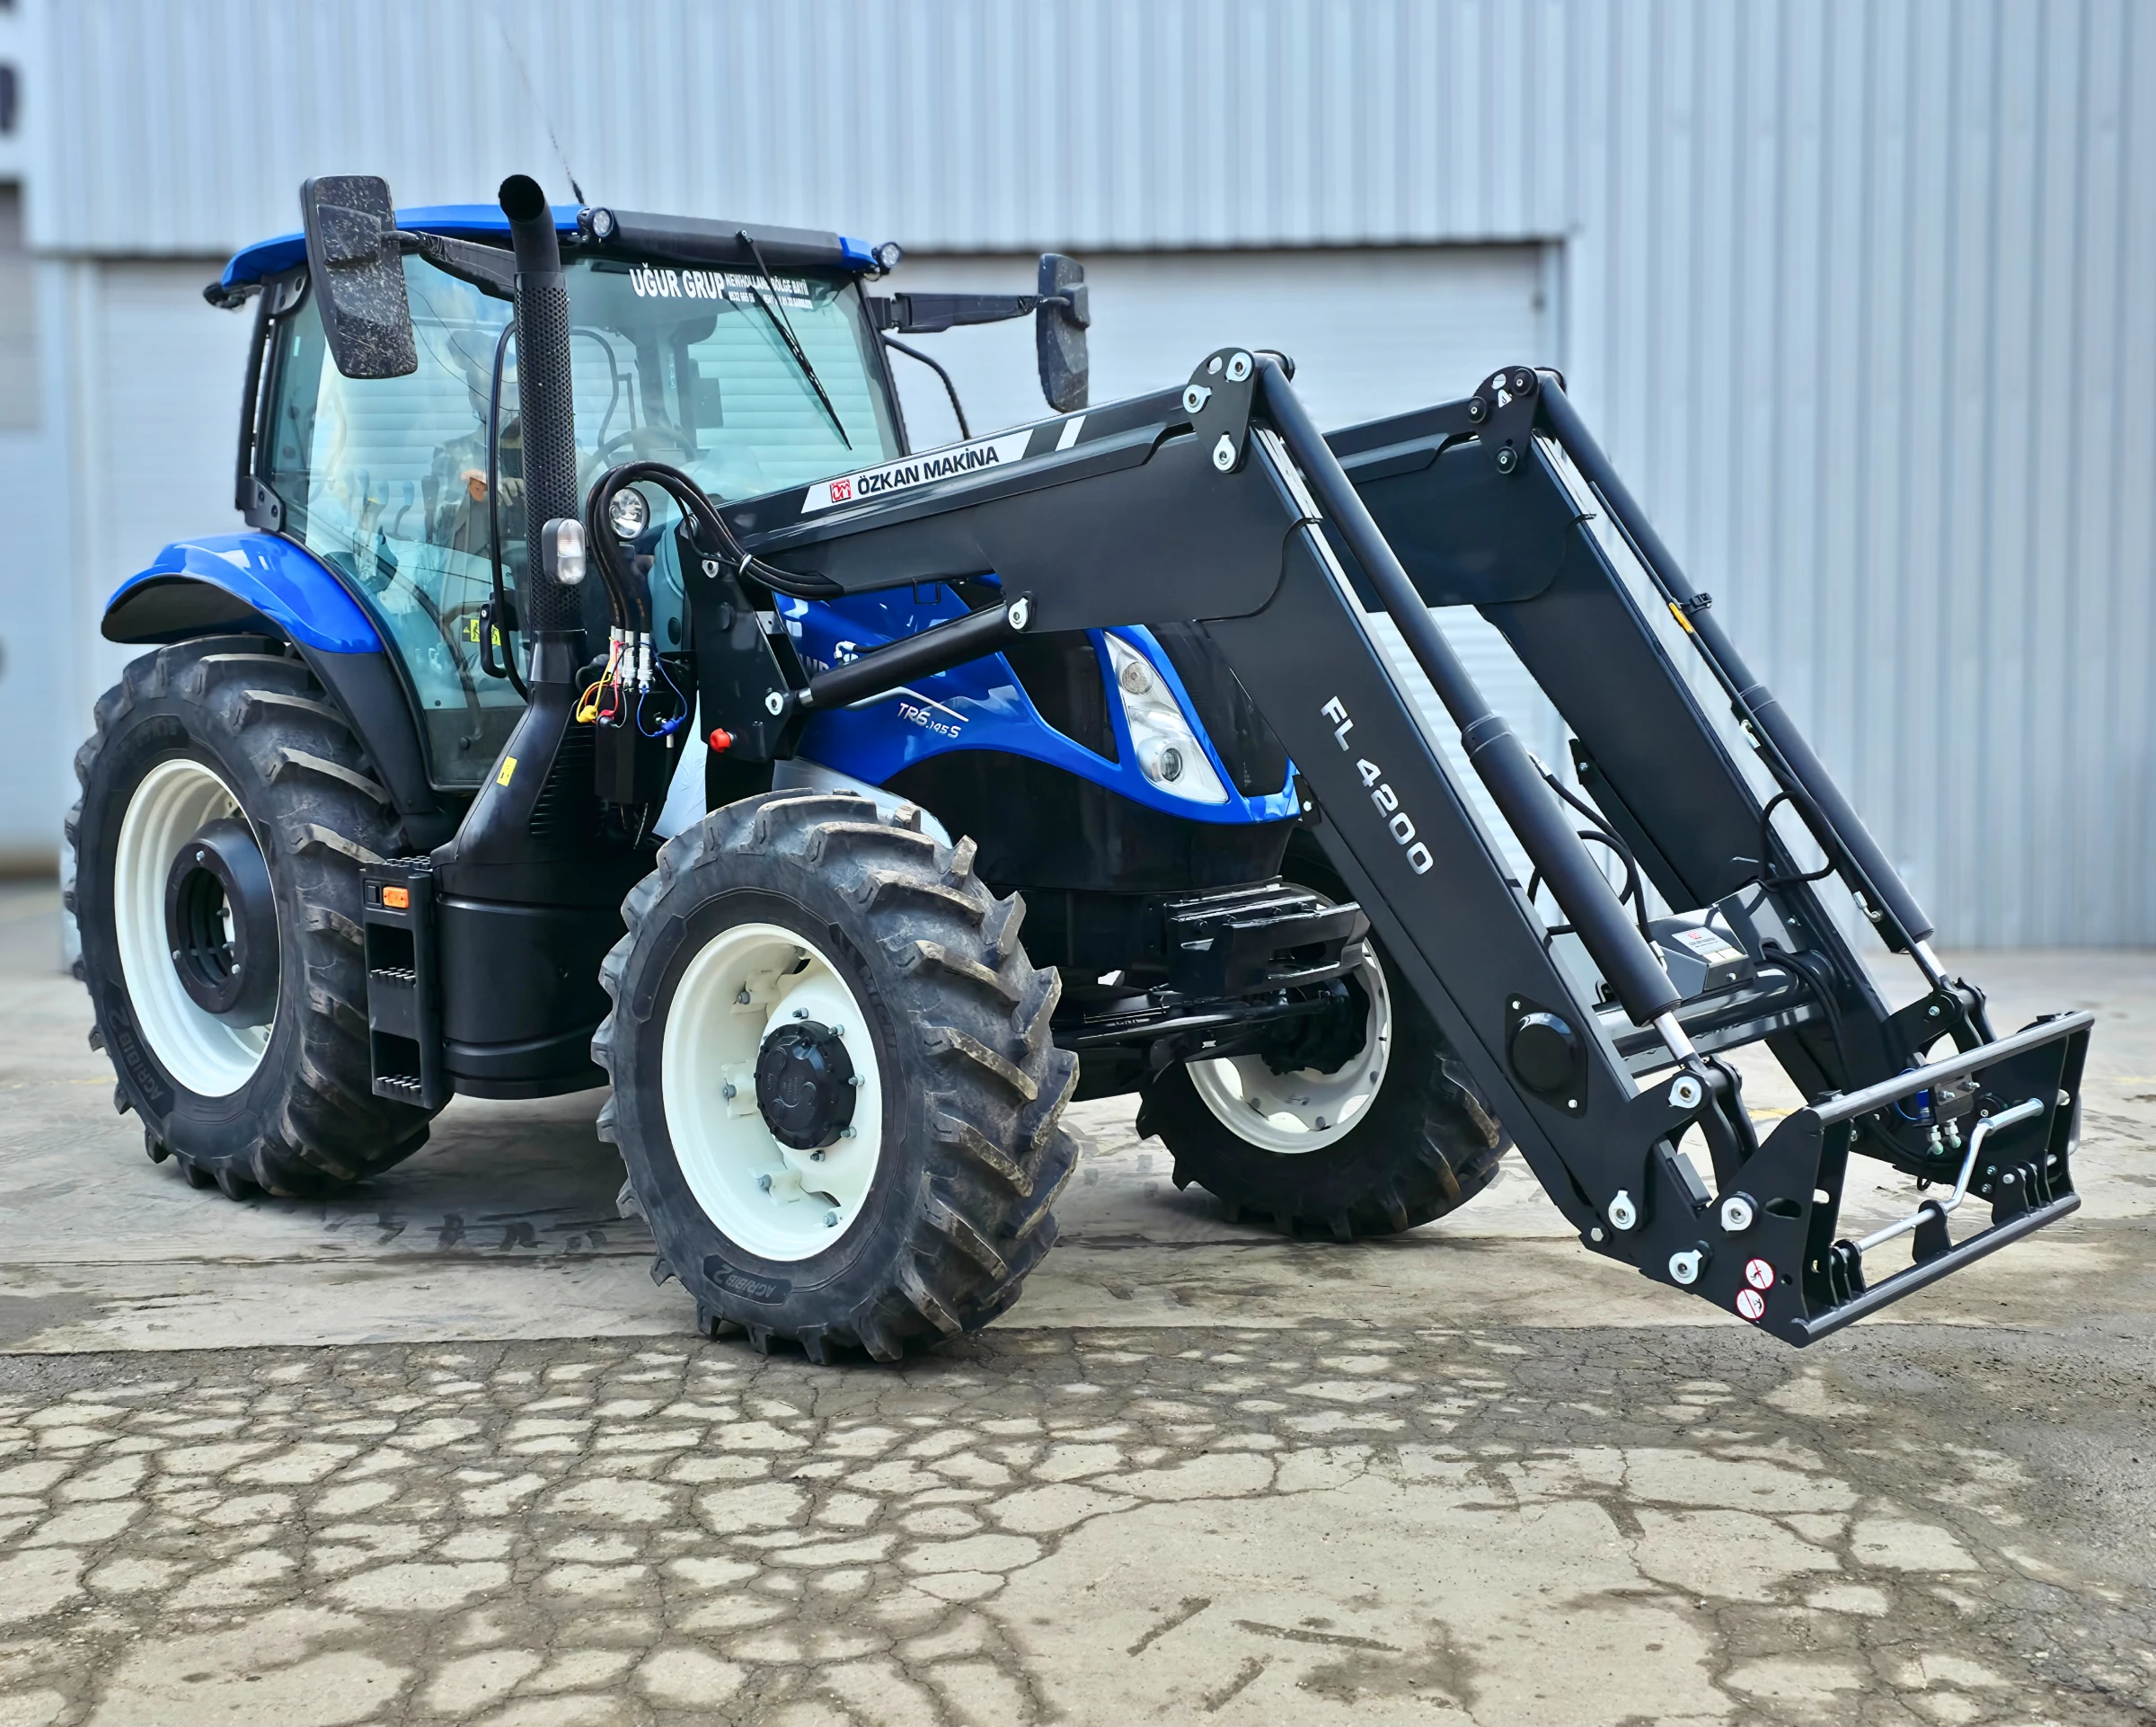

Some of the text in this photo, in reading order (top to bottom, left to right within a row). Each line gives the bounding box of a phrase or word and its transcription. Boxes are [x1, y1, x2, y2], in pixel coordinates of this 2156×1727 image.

[630, 262, 726, 299] UĞUR GRUP
[858, 447, 1000, 495] ÖZKAN MAKİNA
[1320, 695, 1434, 875] FL 4200
[713, 1263, 777, 1298] AGRIBIB 2
